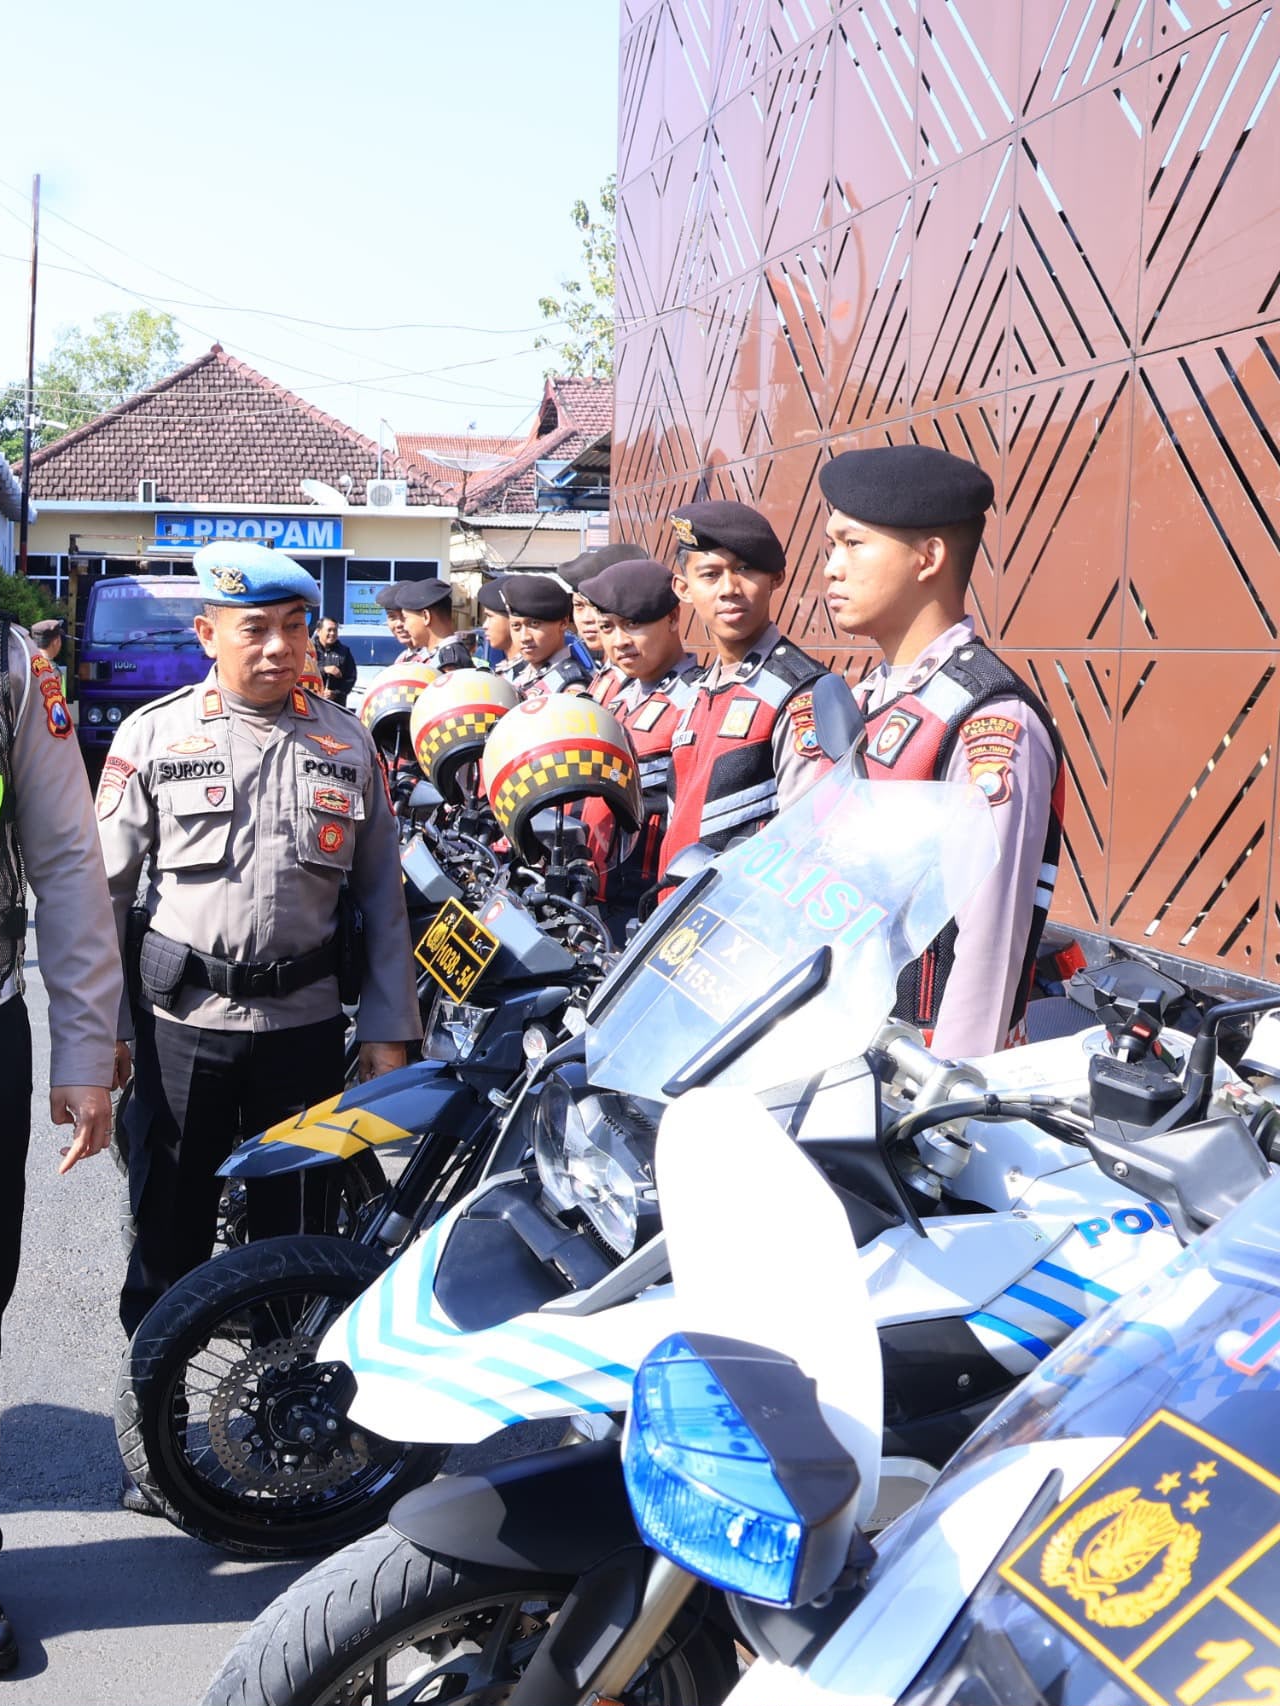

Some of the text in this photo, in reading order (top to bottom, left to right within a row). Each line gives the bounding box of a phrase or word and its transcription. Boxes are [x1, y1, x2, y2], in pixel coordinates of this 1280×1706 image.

[193, 520, 334, 547] PROPAM
[963, 718, 1014, 733] POLRES
[160, 760, 225, 779] SUROYO
[304, 760, 357, 783] POLRI
[722, 832, 889, 948] POLISI
